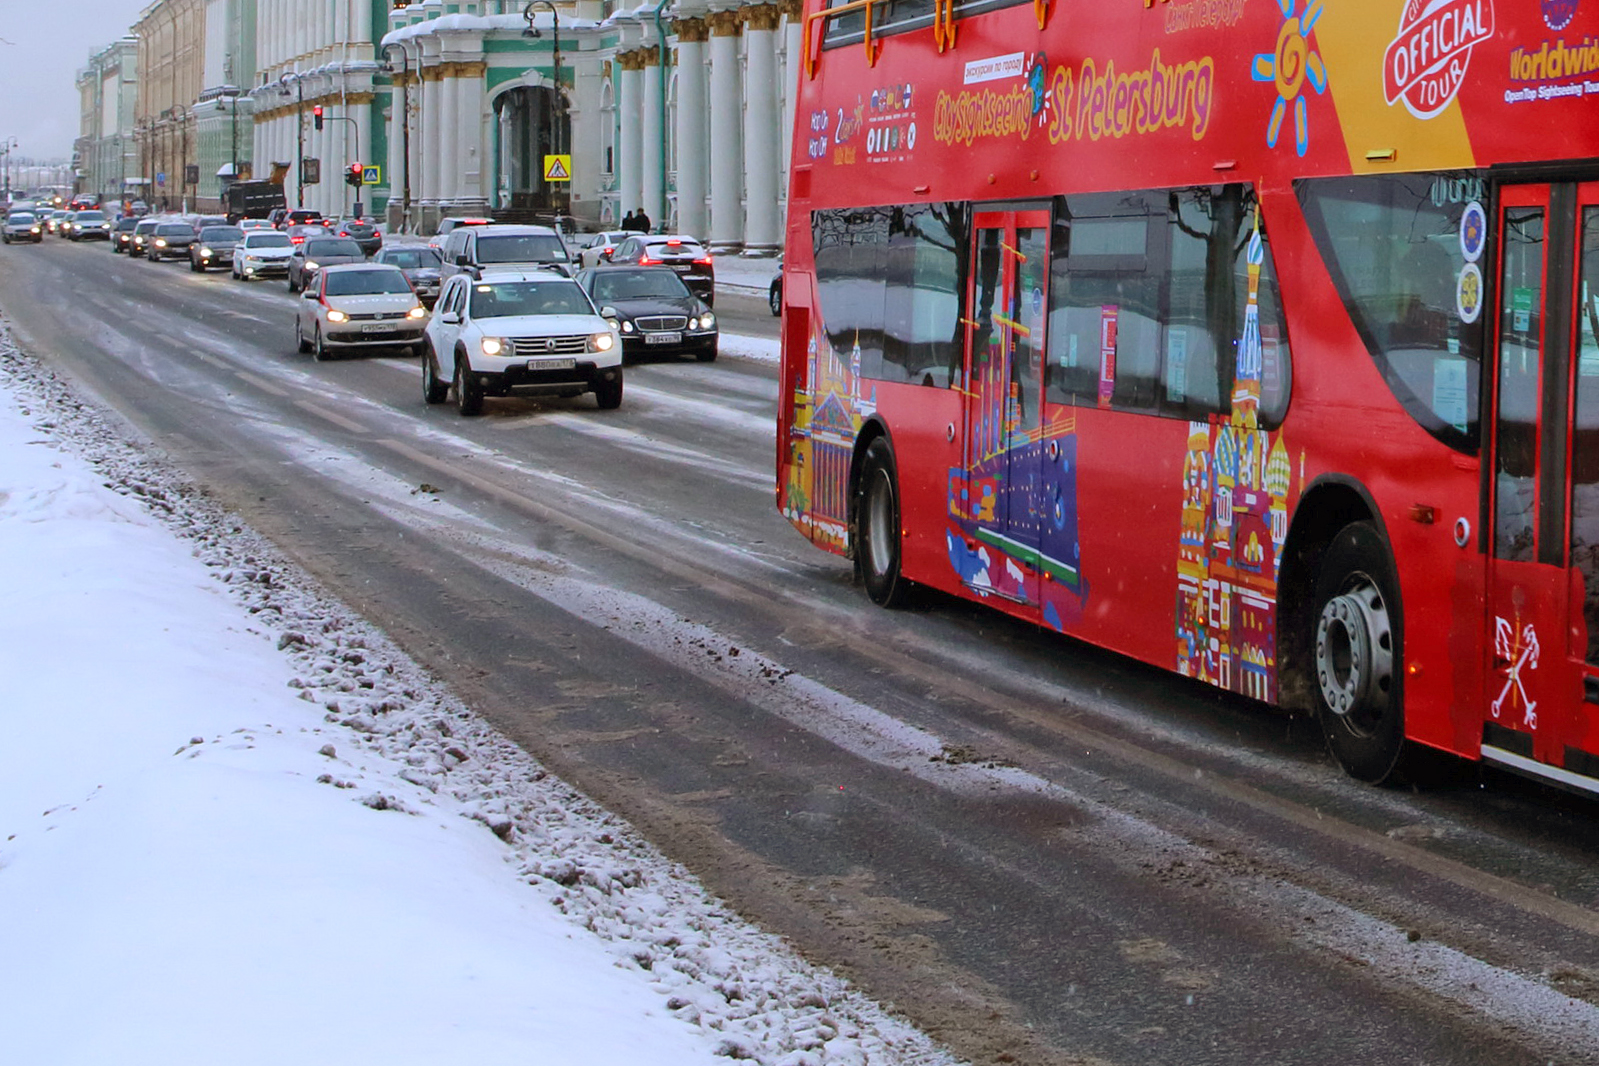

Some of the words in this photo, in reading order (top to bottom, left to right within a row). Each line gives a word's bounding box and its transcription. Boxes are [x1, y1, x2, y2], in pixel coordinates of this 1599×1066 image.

[1394, 0, 1487, 87] OFFICIAL
[1049, 65, 1073, 145] St
[1075, 47, 1214, 141] Petersburg
[1420, 59, 1463, 105] TOUR
[1538, 83, 1582, 100] Sightseeing
